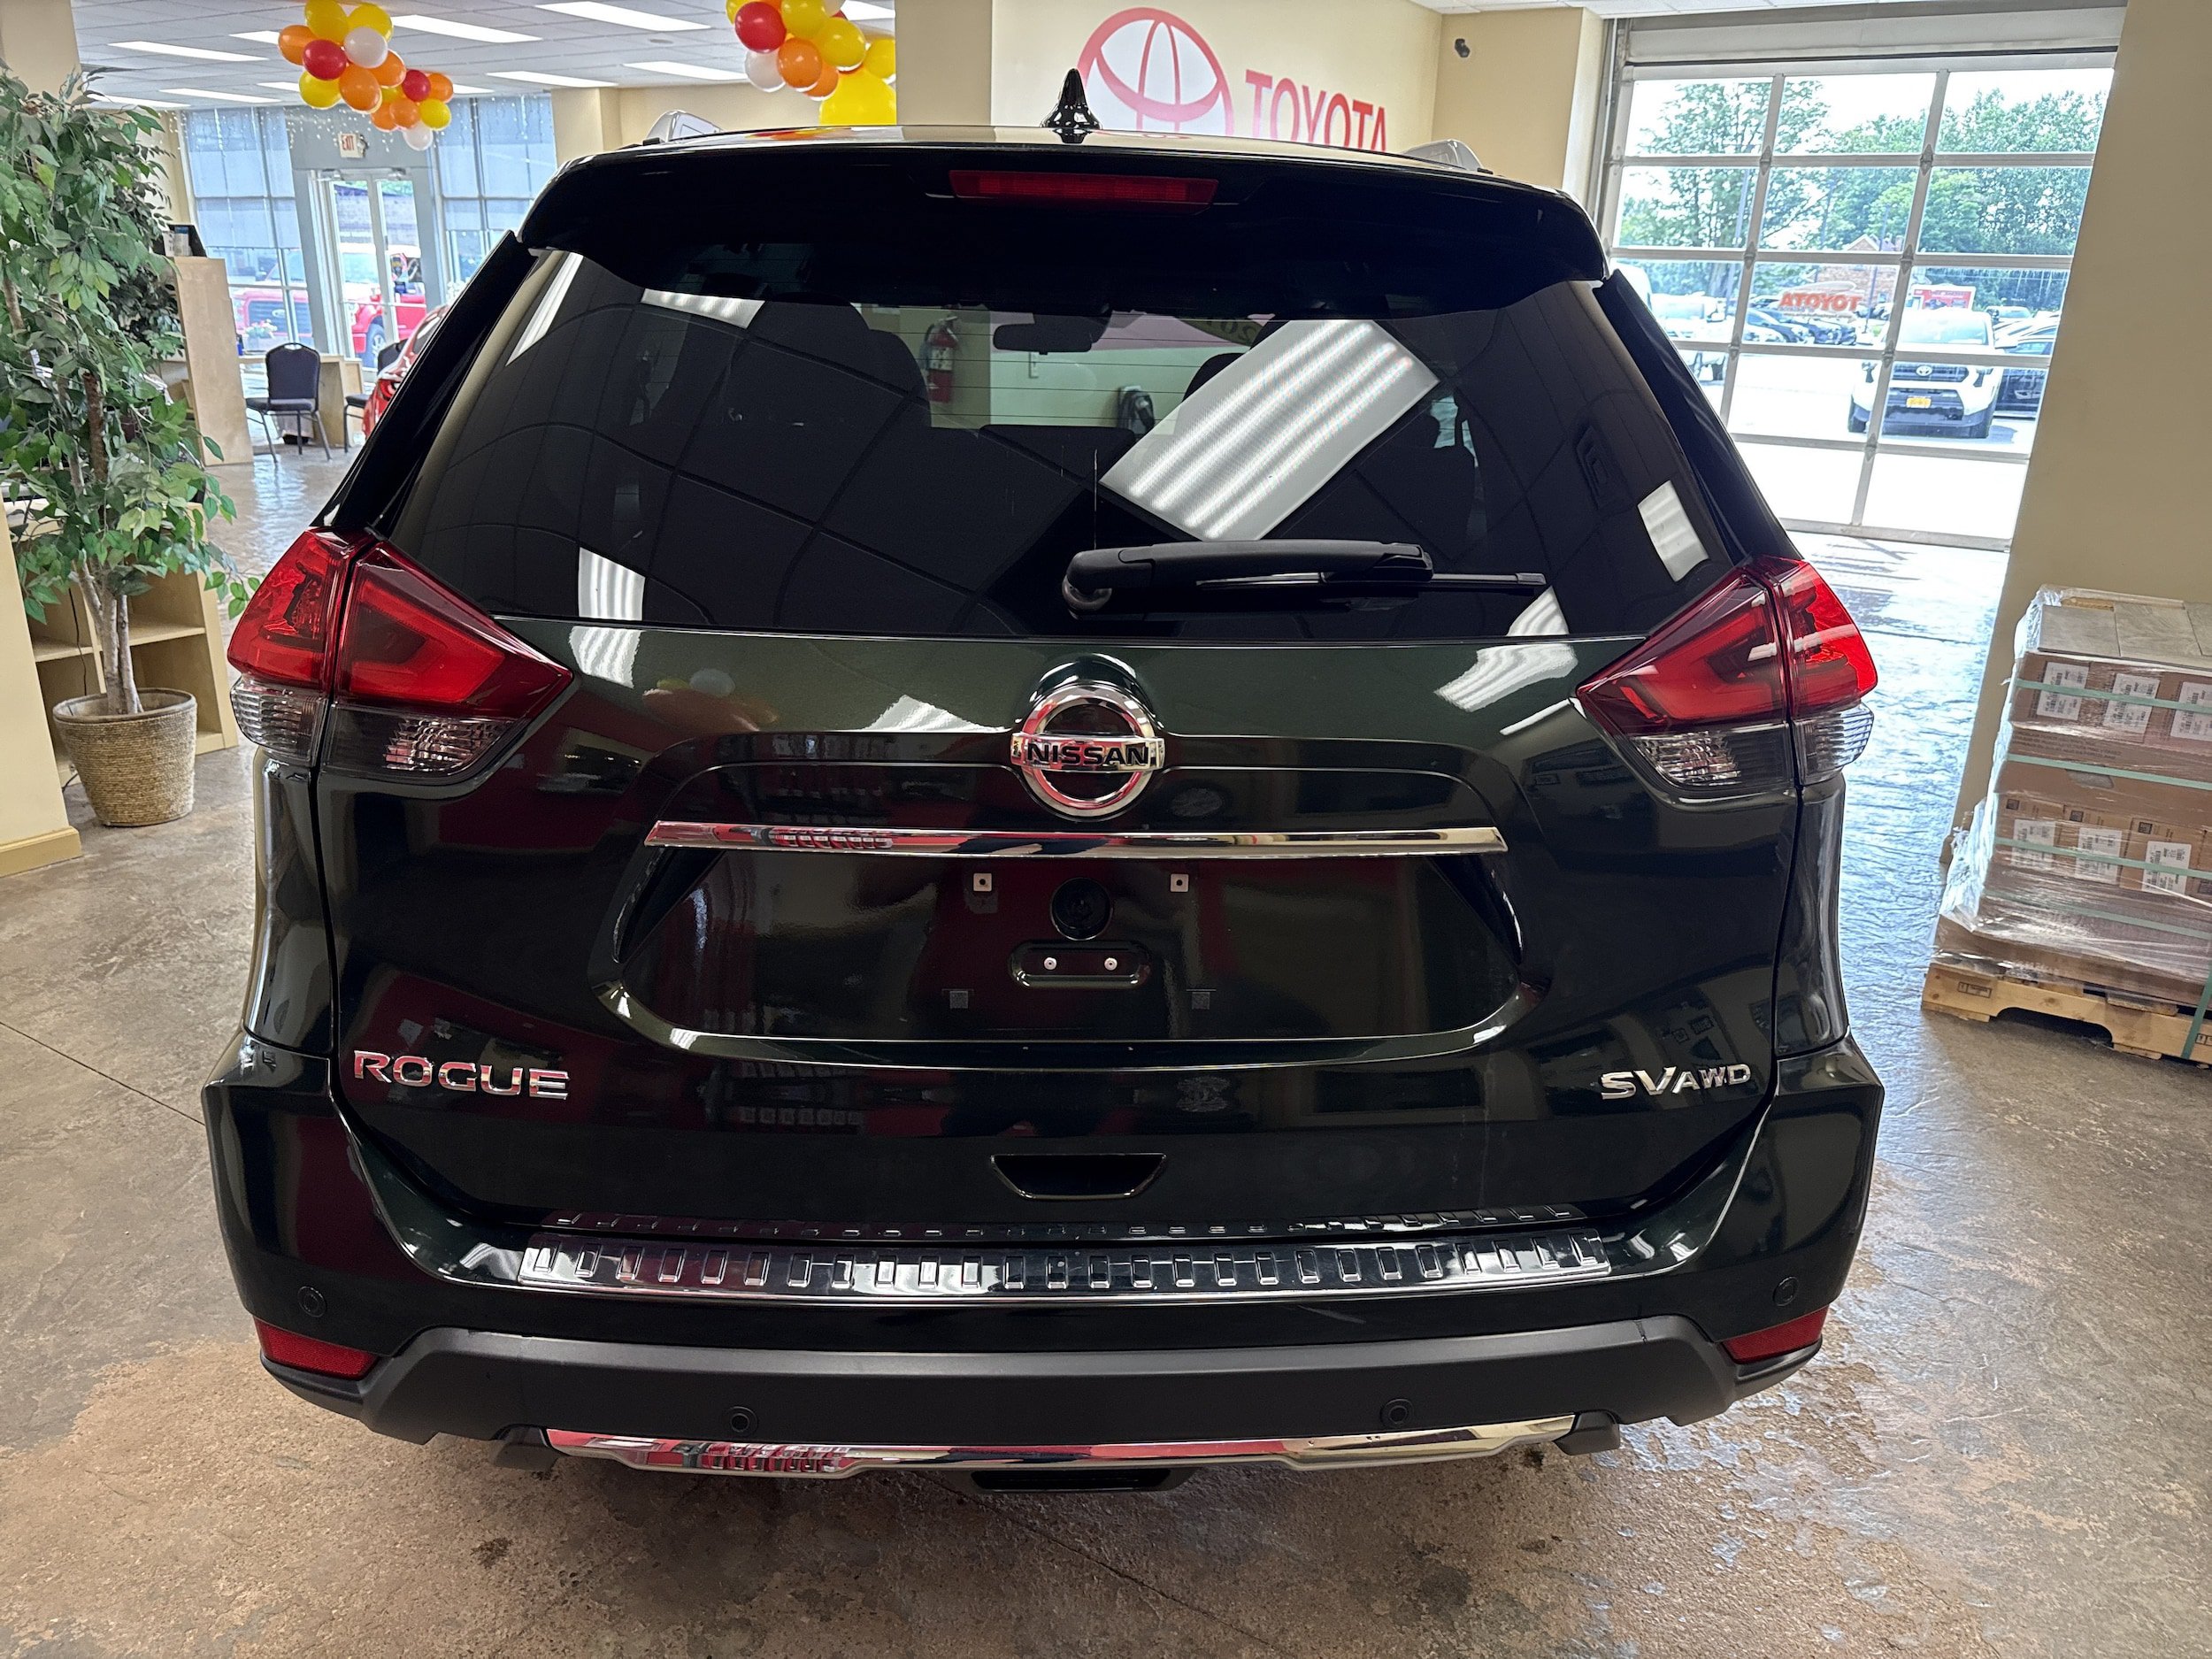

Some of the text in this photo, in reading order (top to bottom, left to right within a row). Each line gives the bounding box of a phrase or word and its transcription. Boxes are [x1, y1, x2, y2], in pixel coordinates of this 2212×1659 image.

[1245, 69, 1386, 152] TOYOTA
[1027, 743, 1148, 766] NISSAN
[354, 1050, 569, 1100] ROGUE
[1601, 1064, 1752, 1100] SV AWD
